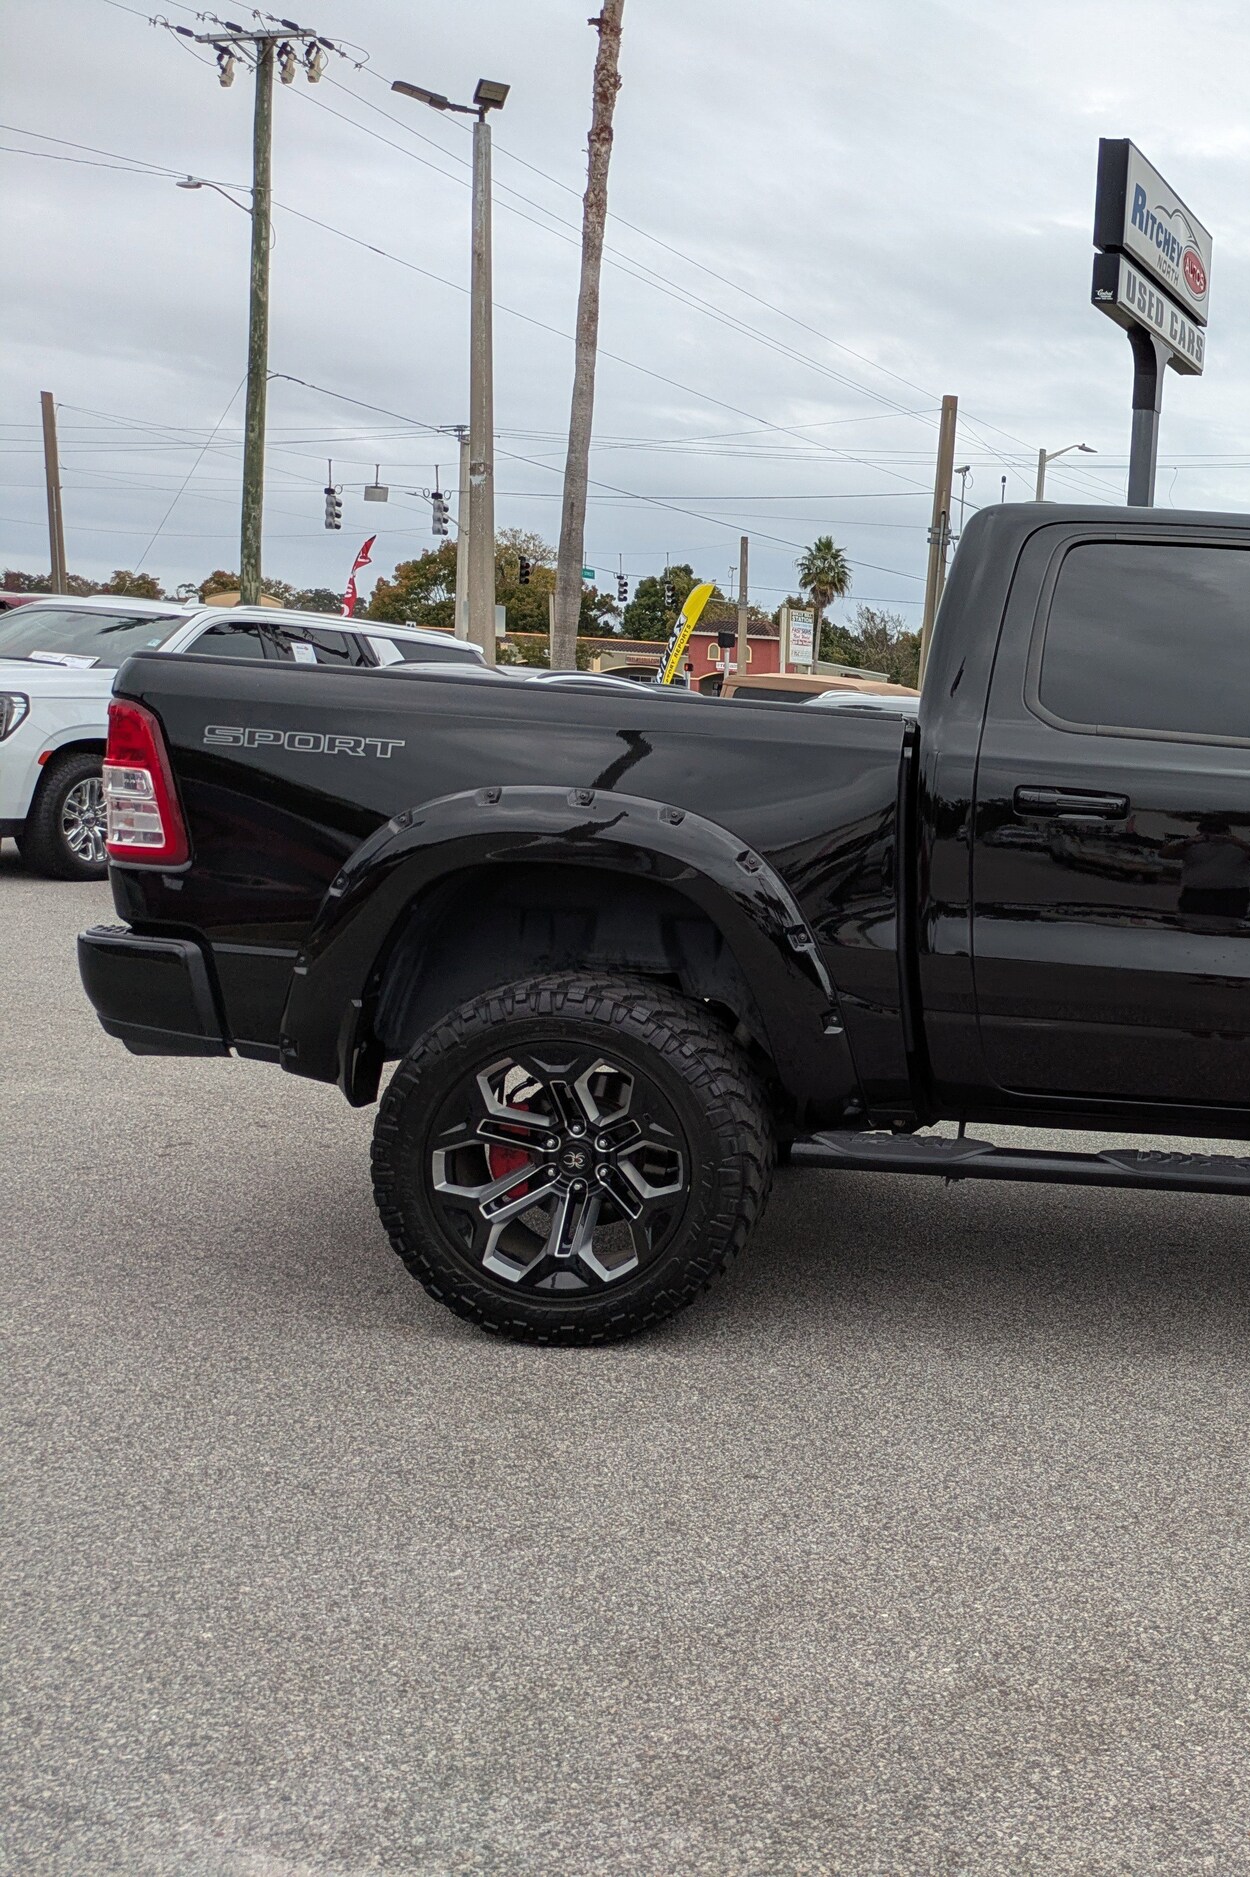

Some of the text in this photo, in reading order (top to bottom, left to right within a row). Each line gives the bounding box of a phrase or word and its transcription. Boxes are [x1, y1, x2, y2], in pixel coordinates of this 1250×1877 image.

[1131, 182, 1183, 268] RITCHEY
[1156, 254, 1180, 287] NORTH
[1184, 257, 1204, 290] AUTOS
[1126, 269, 1204, 364] USED CARS
[673, 623, 692, 659] REPORTS
[203, 724, 405, 759] SPORT
